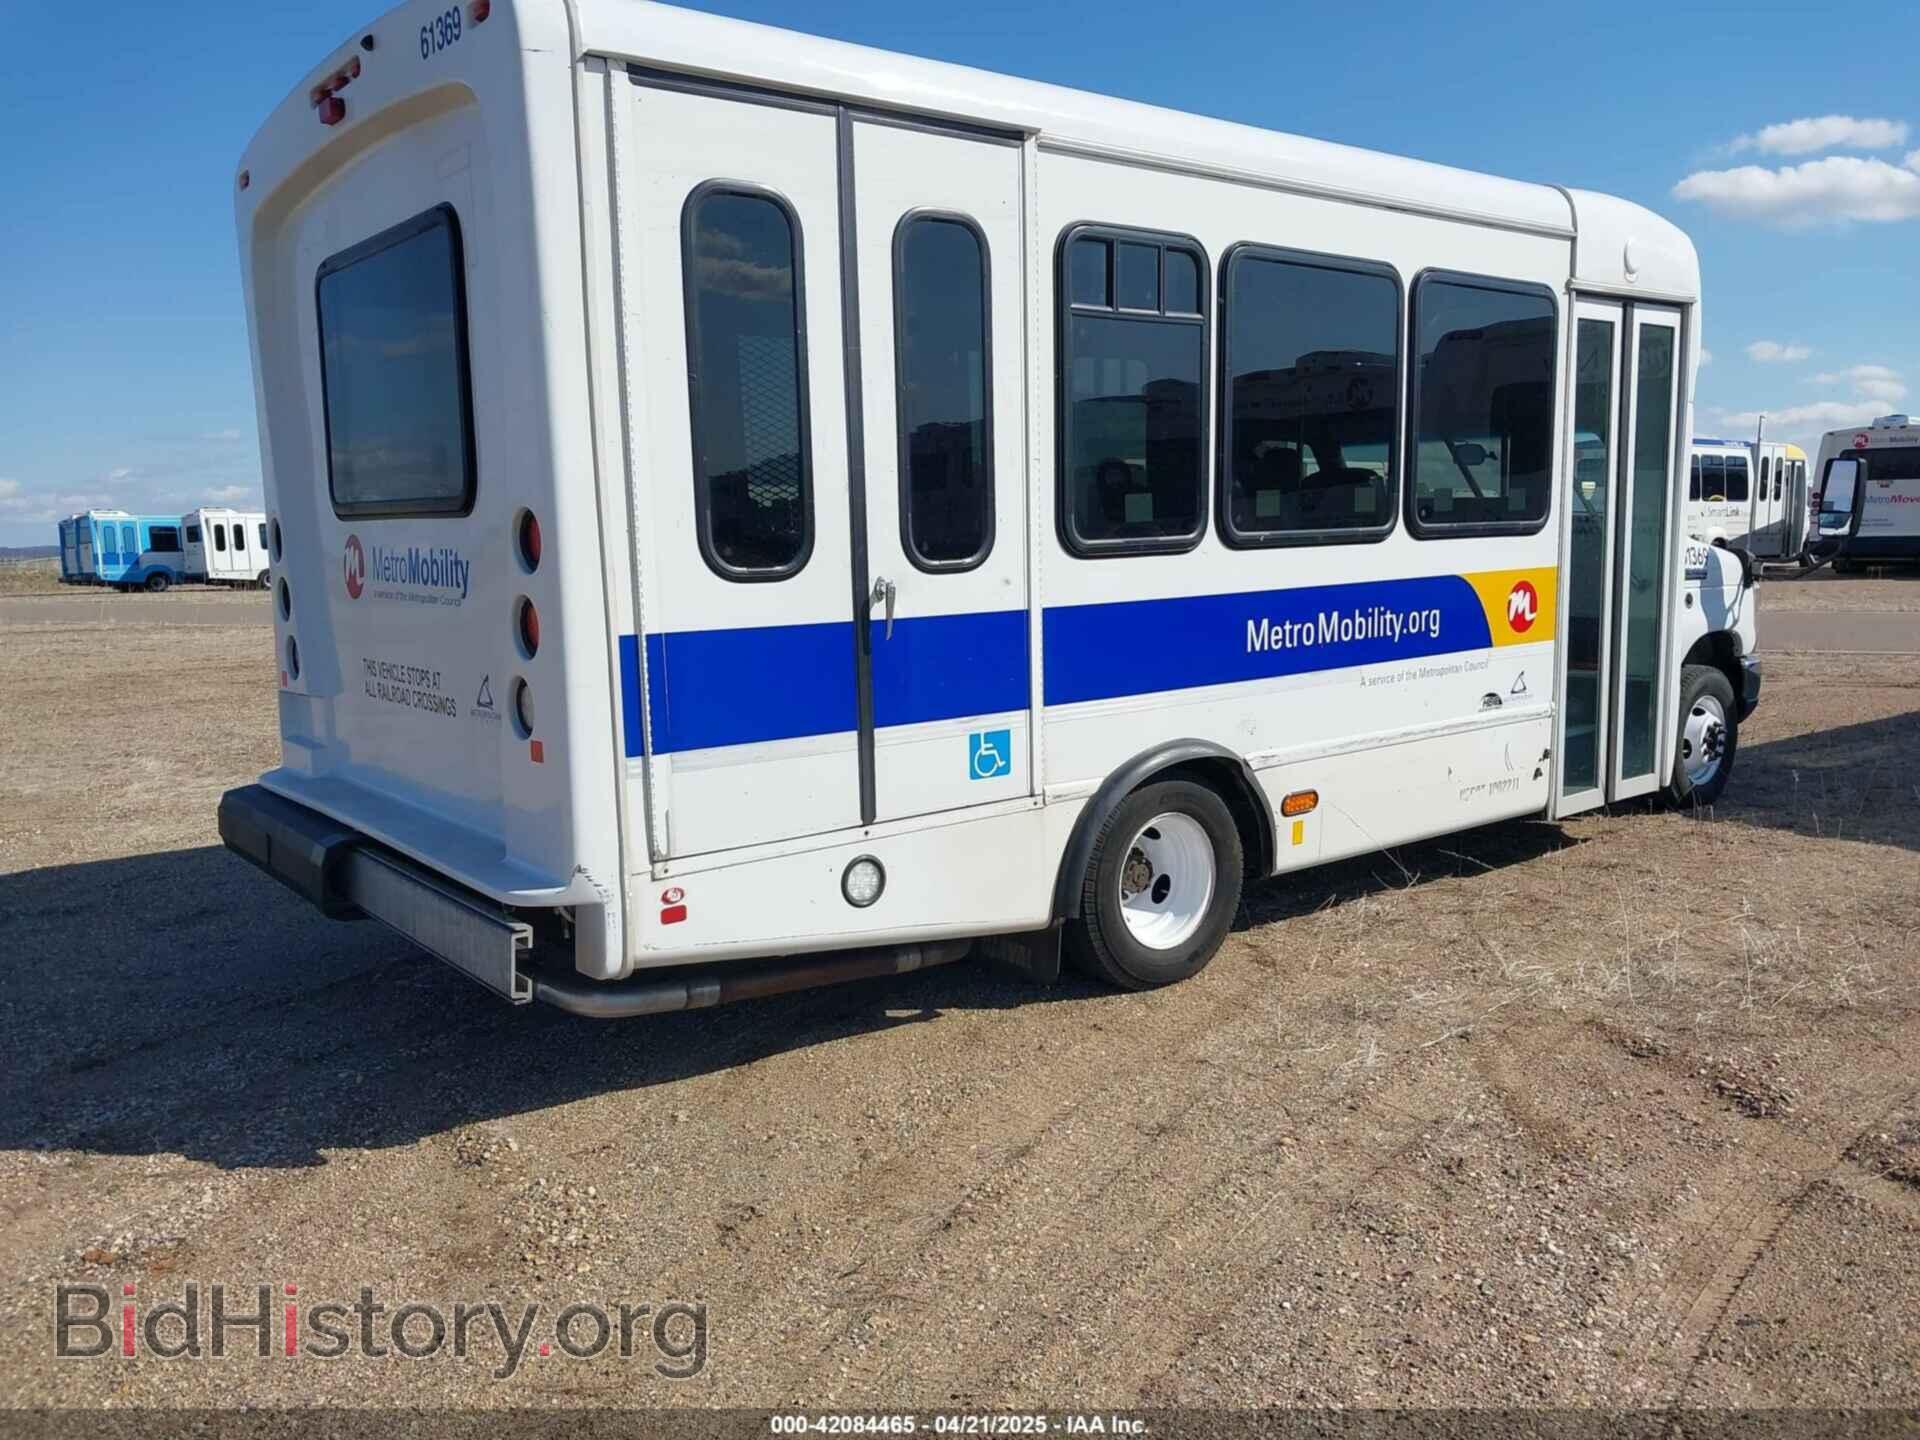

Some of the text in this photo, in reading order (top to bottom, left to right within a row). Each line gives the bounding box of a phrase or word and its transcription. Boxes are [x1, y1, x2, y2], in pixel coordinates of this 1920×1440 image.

[420, 5, 462, 60] 61369
[372, 546, 469, 600] MetroMobility
[1684, 547, 1709, 566] 1369
[1247, 606, 1441, 653] MetroMobility.org
[362, 658, 441, 690] THIS VEHICLE STOPS AT
[1368, 674, 1395, 687] service
[1397, 672, 1404, 682] of
[1406, 670, 1417, 681] the
[365, 679, 457, 718] ALL RAILROAD CROSSINGS
